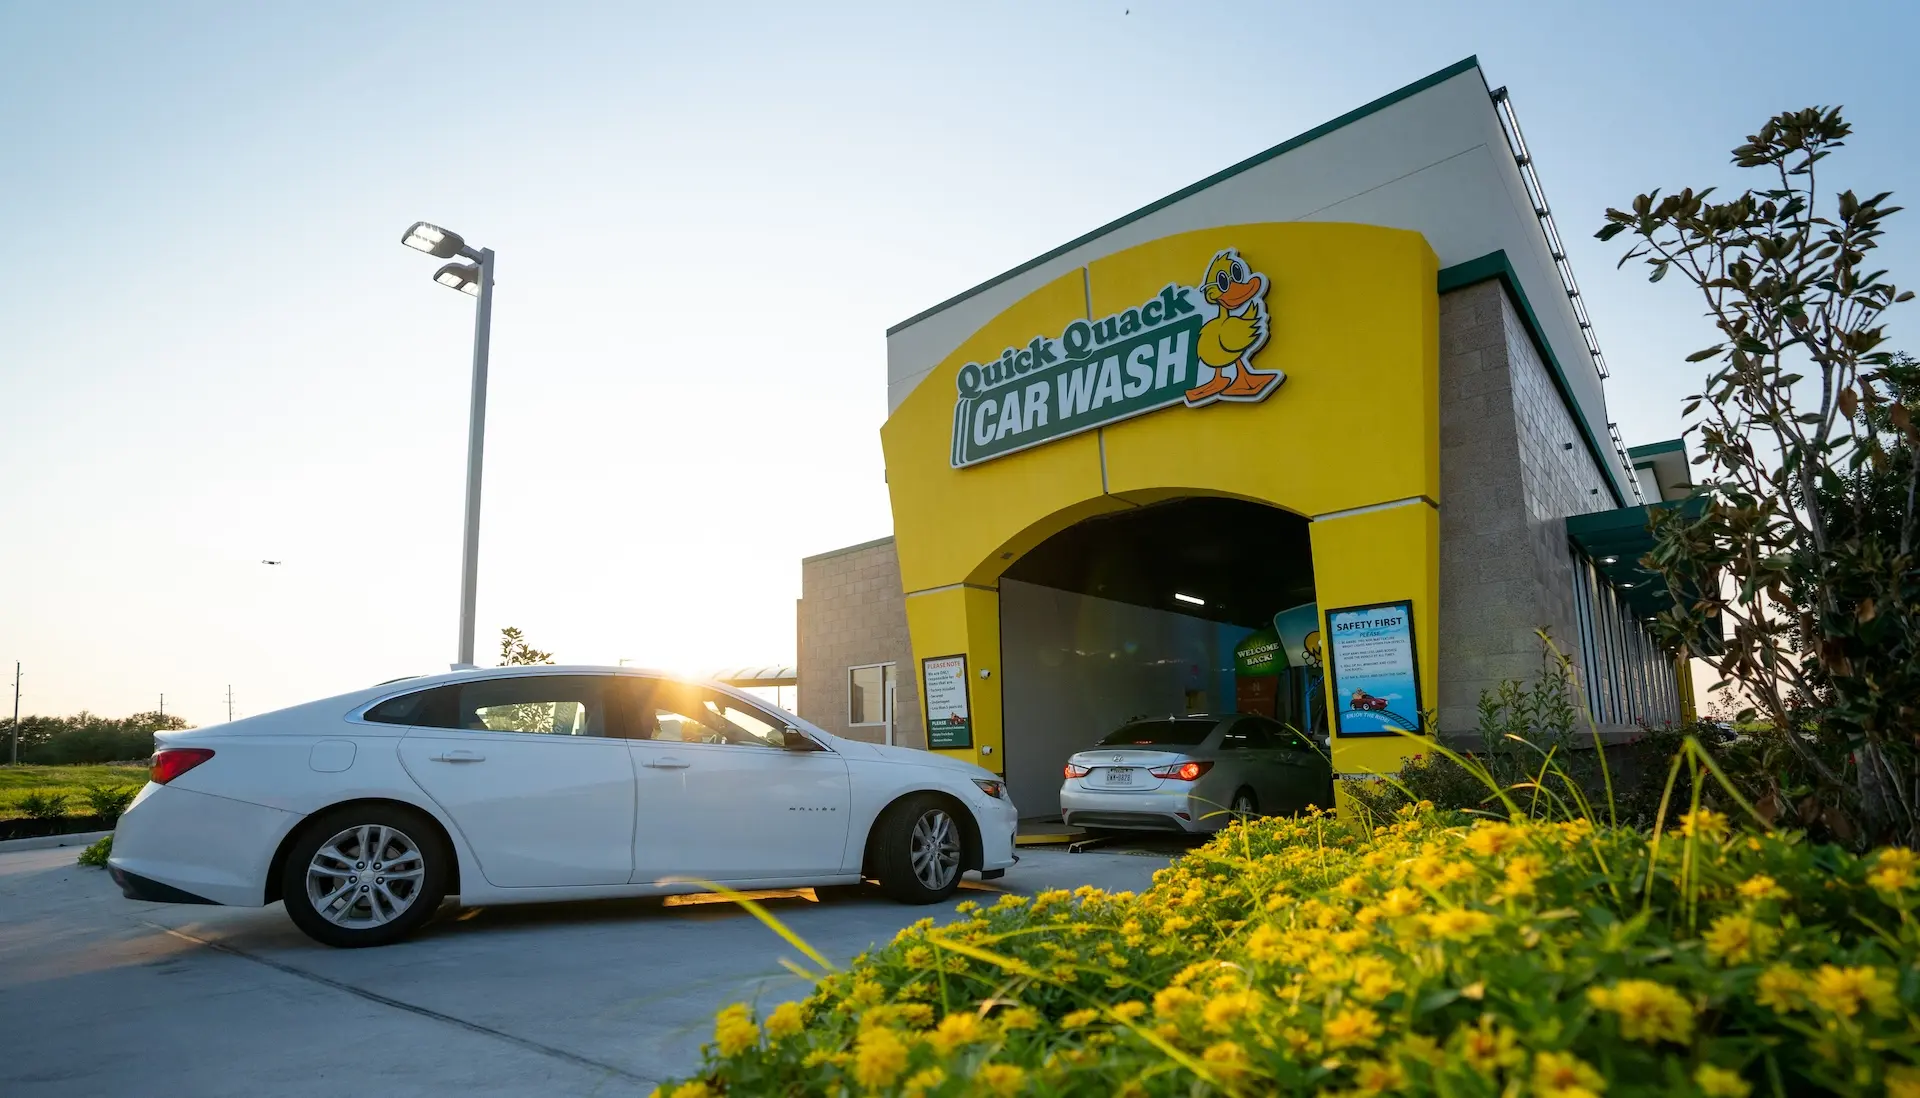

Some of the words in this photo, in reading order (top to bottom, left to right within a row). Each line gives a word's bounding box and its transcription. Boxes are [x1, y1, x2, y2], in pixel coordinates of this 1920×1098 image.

[957, 336, 1057, 399] Quick
[1063, 285, 1196, 361] Quack
[973, 380, 1050, 447] CAR
[1057, 329, 1190, 420] WASH
[1337, 620, 1373, 631] SAFETY
[1375, 617, 1402, 627] FIRST
[1236, 642, 1280, 658] WELCOME
[1246, 653, 1273, 666] BACK!
